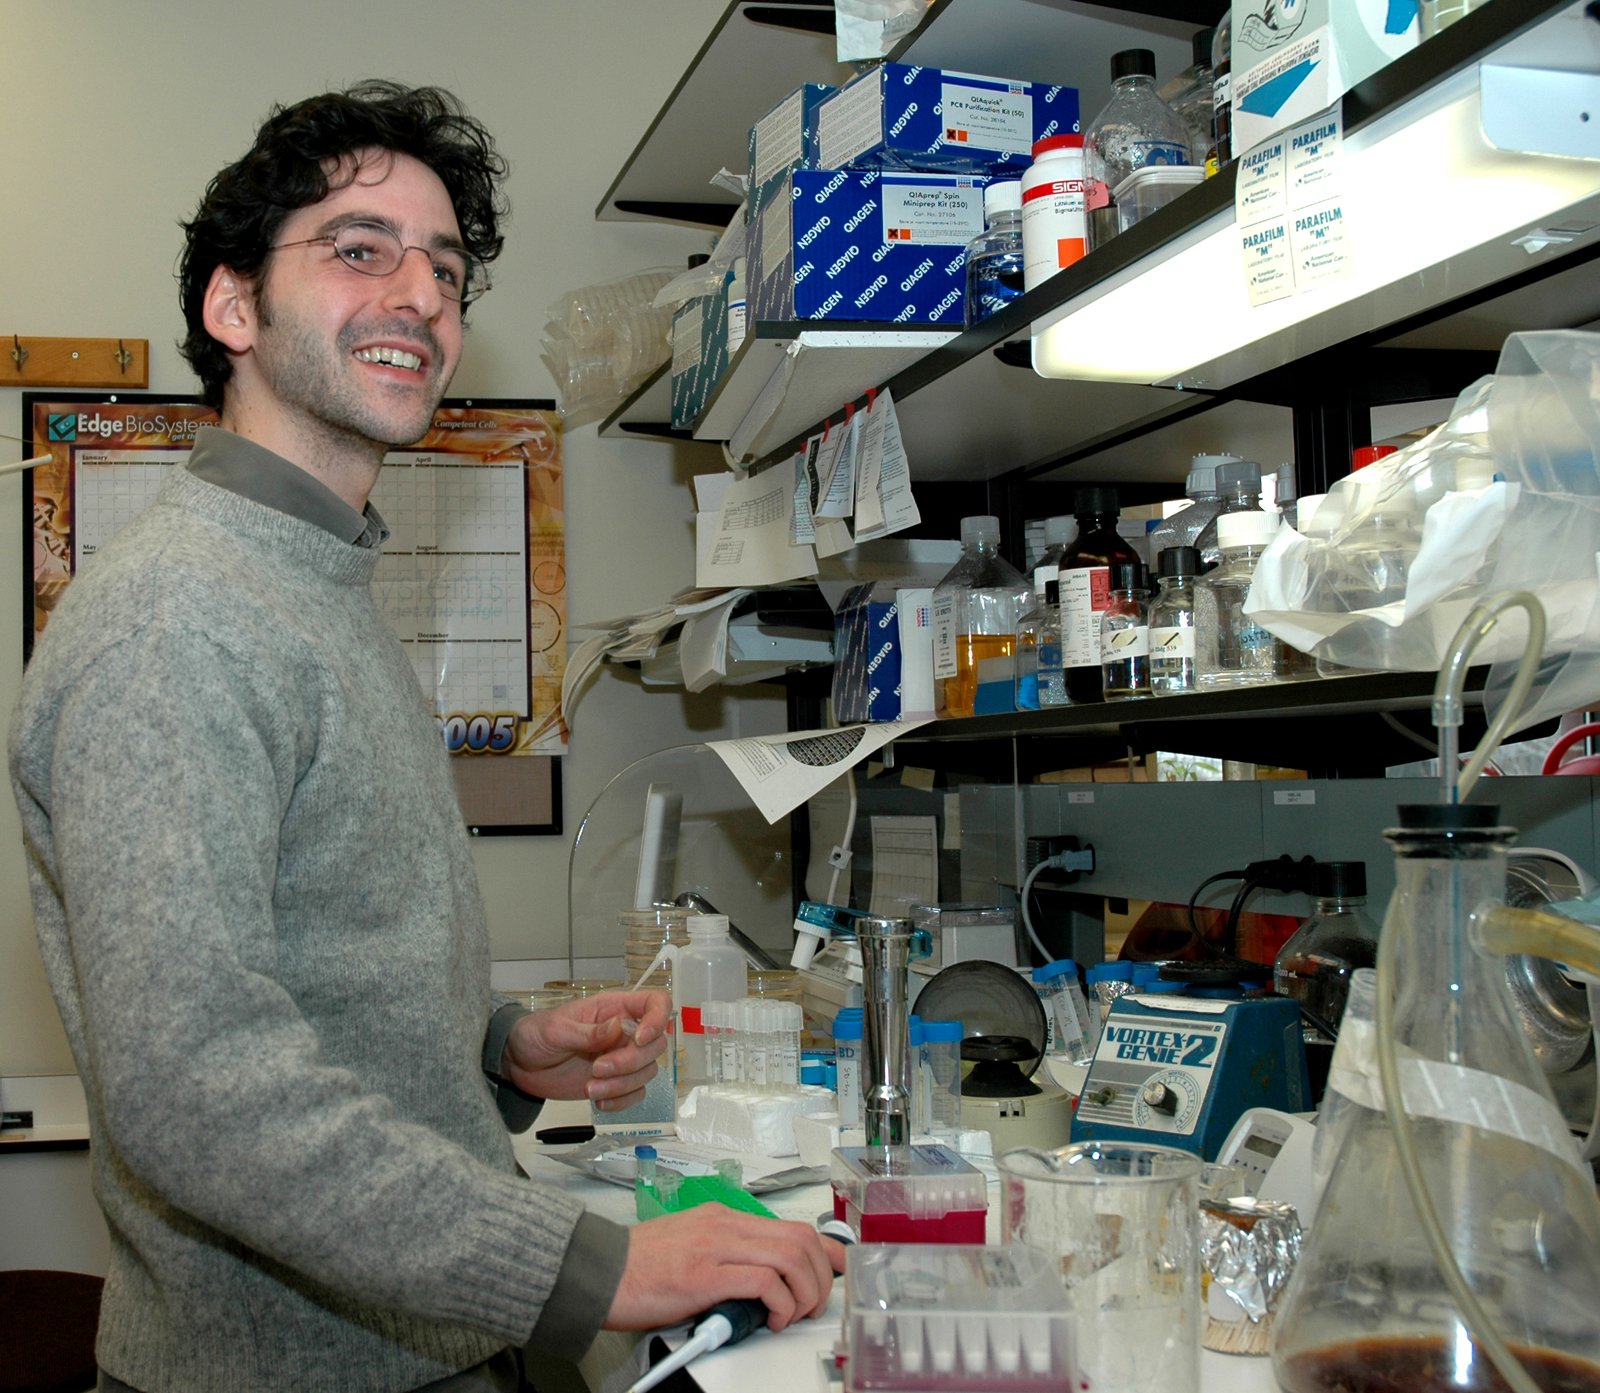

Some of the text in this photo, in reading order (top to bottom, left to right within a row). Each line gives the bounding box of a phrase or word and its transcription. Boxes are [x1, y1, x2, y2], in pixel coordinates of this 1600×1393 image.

[950, 101, 963, 109] PCR
[965, 103, 1000, 113] Purification
[1012, 109, 1024, 118] (50)
[971, 96, 1000, 105] QIAquick
[889, 102, 918, 138] QIAGEN
[1292, 122, 1337, 150] PARAFILM
[1241, 144, 1282, 170] PARAFILM
[815, 170, 849, 204] QIAGEN
[909, 191, 940, 200] QIAprep
[843, 199, 878, 233] QIAGEN
[903, 200, 936, 208] Miniprep
[949, 201, 968, 209] (250)
[1295, 207, 1343, 232] PARAFILM
[797, 216, 831, 250] QIAGEN
[1243, 226, 1285, 249] PARAFILM
[825, 245, 859, 279] QIAGEN
[900, 258, 934, 292] QIAGEN
[854, 274, 888, 309] QIAGEN
[928, 288, 962, 322] QIAGEN
[77, 414, 123, 438] Edge
[434, 420, 497, 430] Competent Cells
[867, 642, 893, 675] QIAGEN
[434, 715, 515, 751] 005
[838, 1047, 855, 1058] BD
[1116, 1034, 1218, 1068] GENIE 2
